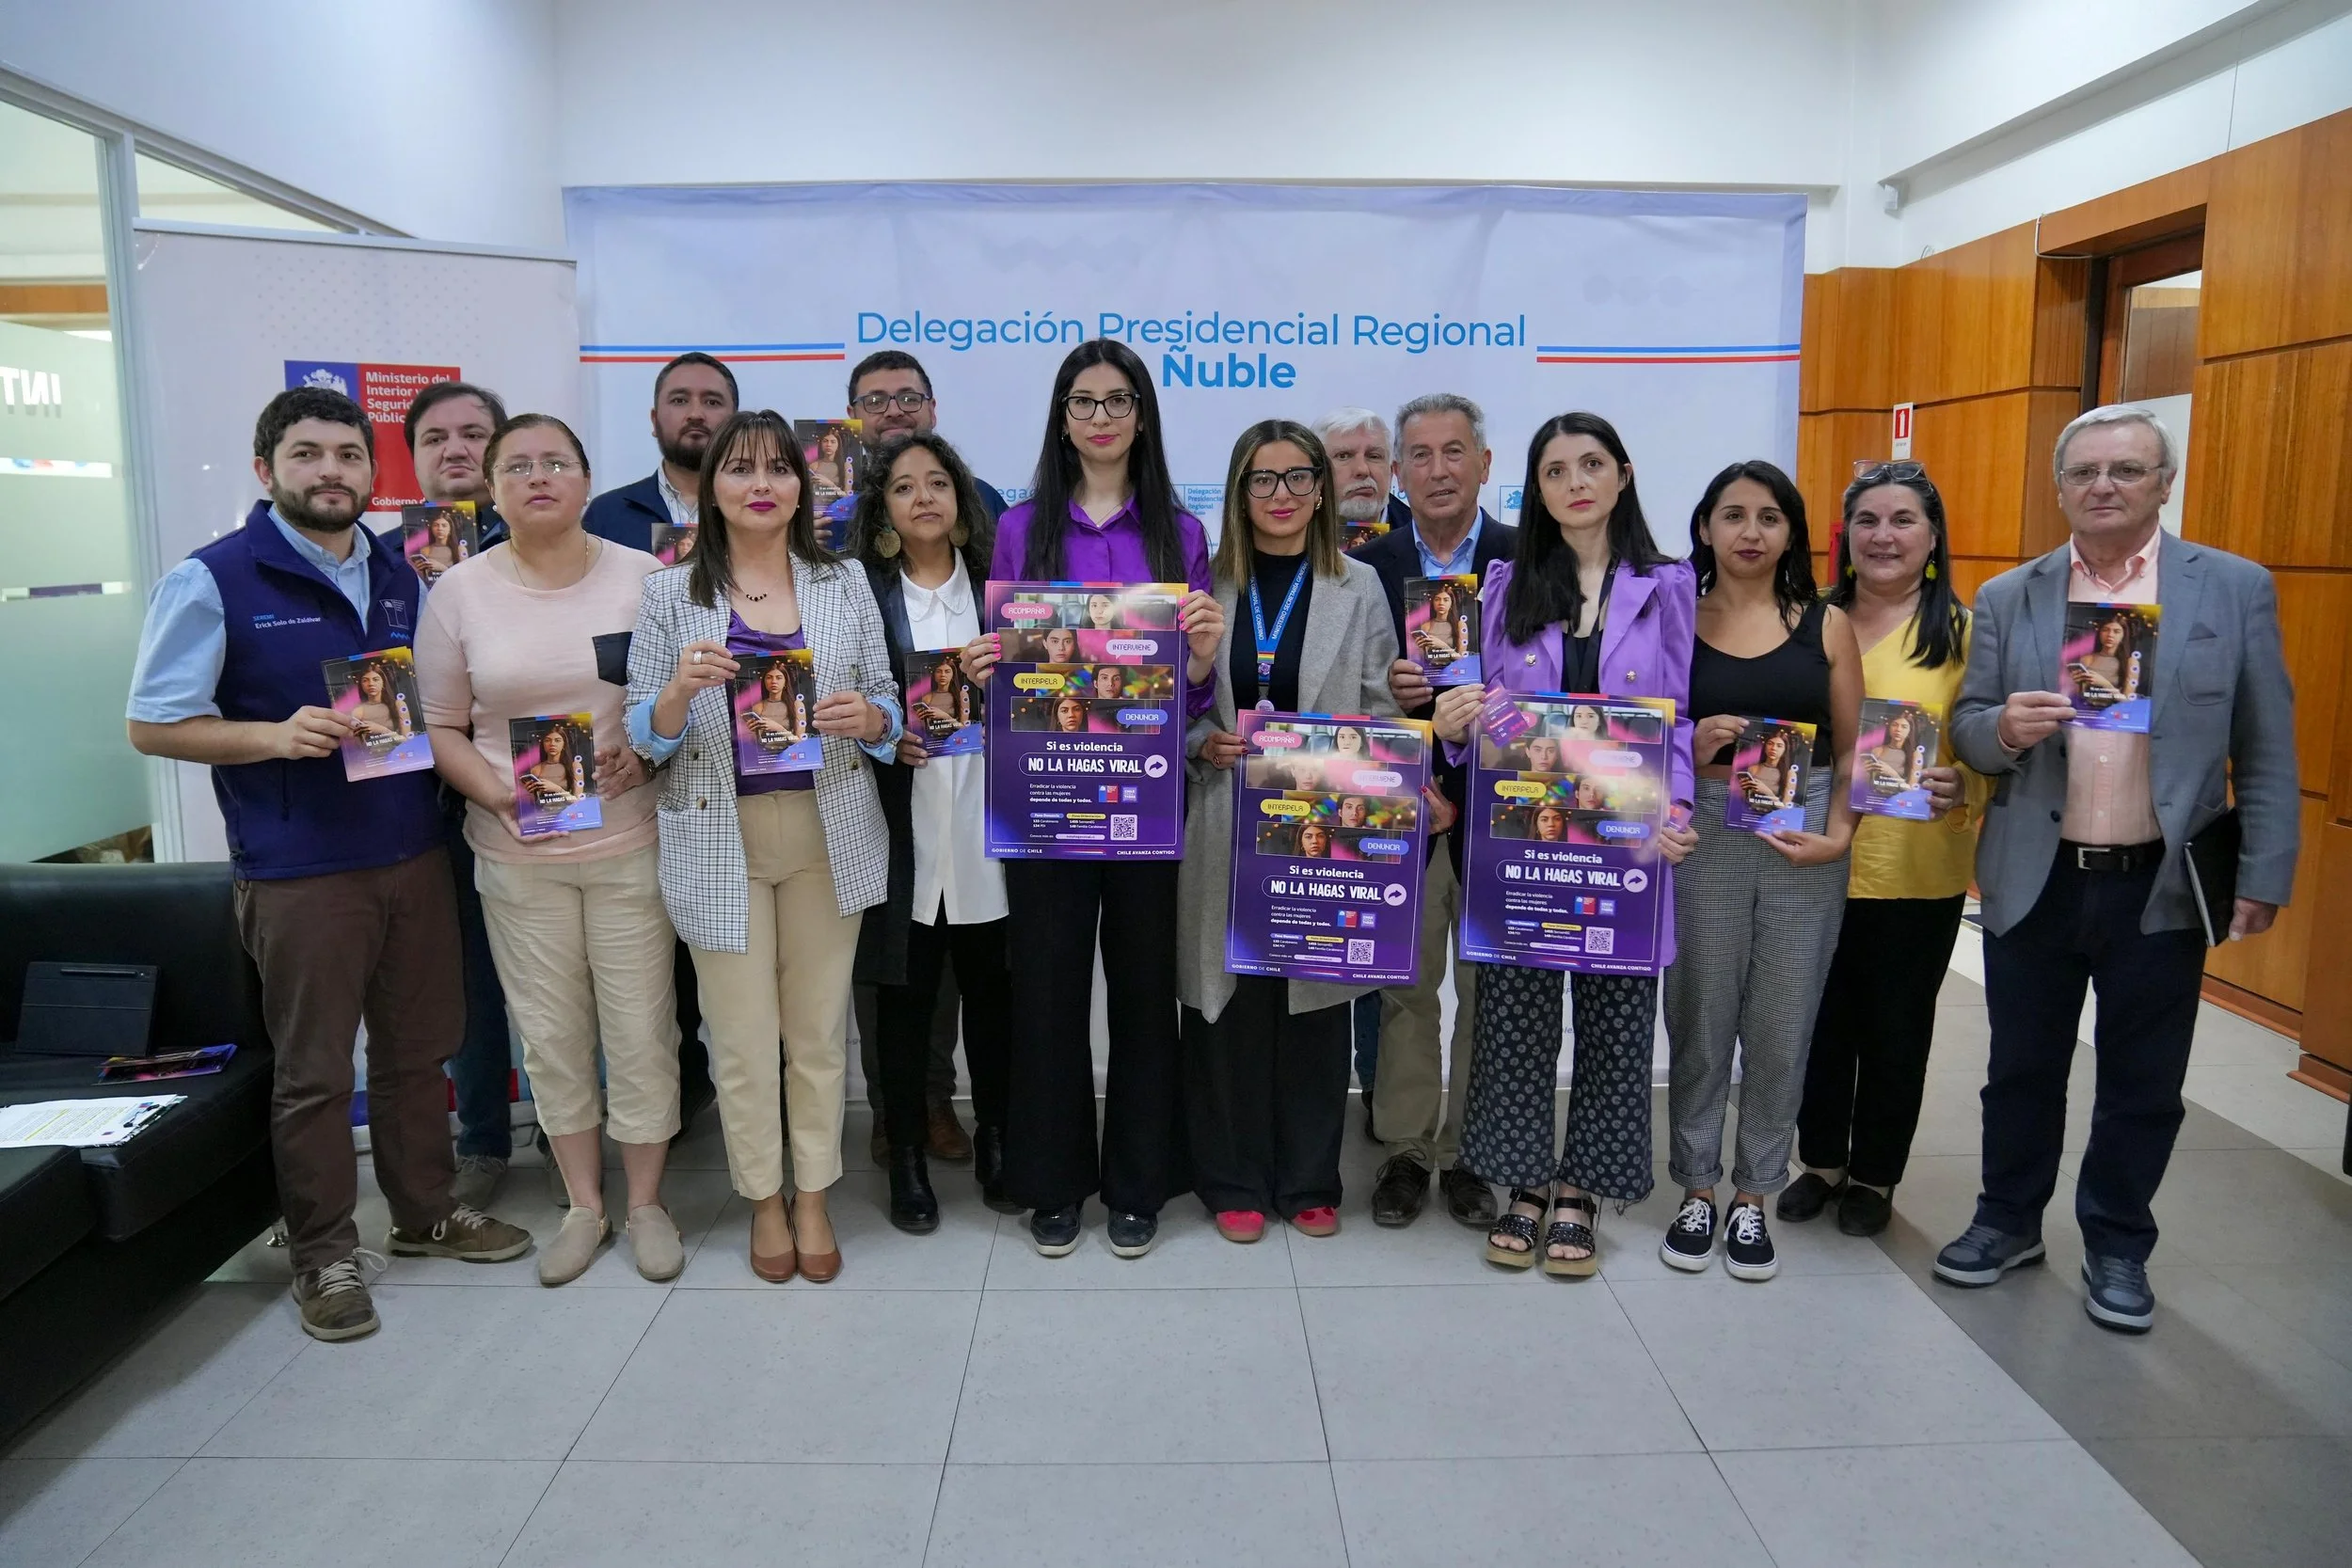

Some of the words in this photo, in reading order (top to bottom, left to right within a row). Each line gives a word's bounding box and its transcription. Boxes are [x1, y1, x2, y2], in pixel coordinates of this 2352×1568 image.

[857, 310, 1083, 352] Delegación
[1099, 310, 1338, 345] Presidencial
[1354, 313, 1525, 354] Regional
[1162, 344, 1296, 388] Ñuble
[365, 372, 429, 384] Ministerio
[367, 385, 412, 397] Interior
[368, 411, 405, 423] Públic
[372, 497, 418, 505] Gobierno
[1272, 611, 1287, 640] MINISTERIO
[1296, 562, 1308, 583] GENERAL
[1008, 606, 1046, 615] ACOMPAÑA
[1256, 613, 1264, 640] GOBIERNO
[1259, 734, 1295, 744] ACOMPAÑA
[1046, 741, 1057, 751] Si
[1073, 742, 1123, 752] violencia
[1028, 758, 1044, 771] NO
[1048, 758, 1063, 772] LA
[1067, 758, 1104, 772] HAGAS
[1109, 759, 1142, 773] VIRAL
[1502, 785, 1539, 793] INTERPELA
[1606, 825, 1641, 834] DENUNCIA
[1367, 843, 1400, 851] DENUNCIA
[1525, 850, 1535, 859] Si
[1552, 851, 1602, 863] violencia
[1289, 865, 1299, 874] Si
[1316, 867, 1364, 879] violencia
[1505, 865, 1520, 879] NO
[1525, 866, 1541, 880] LA
[1545, 868, 1582, 883] HAGAS
[1587, 871, 1620, 886] VIRAL
[1271, 880, 1286, 894] NO
[1290, 881, 1305, 895] LA
[1309, 883, 1345, 898] HAGAS
[1350, 886, 1381, 900] VIRAL
